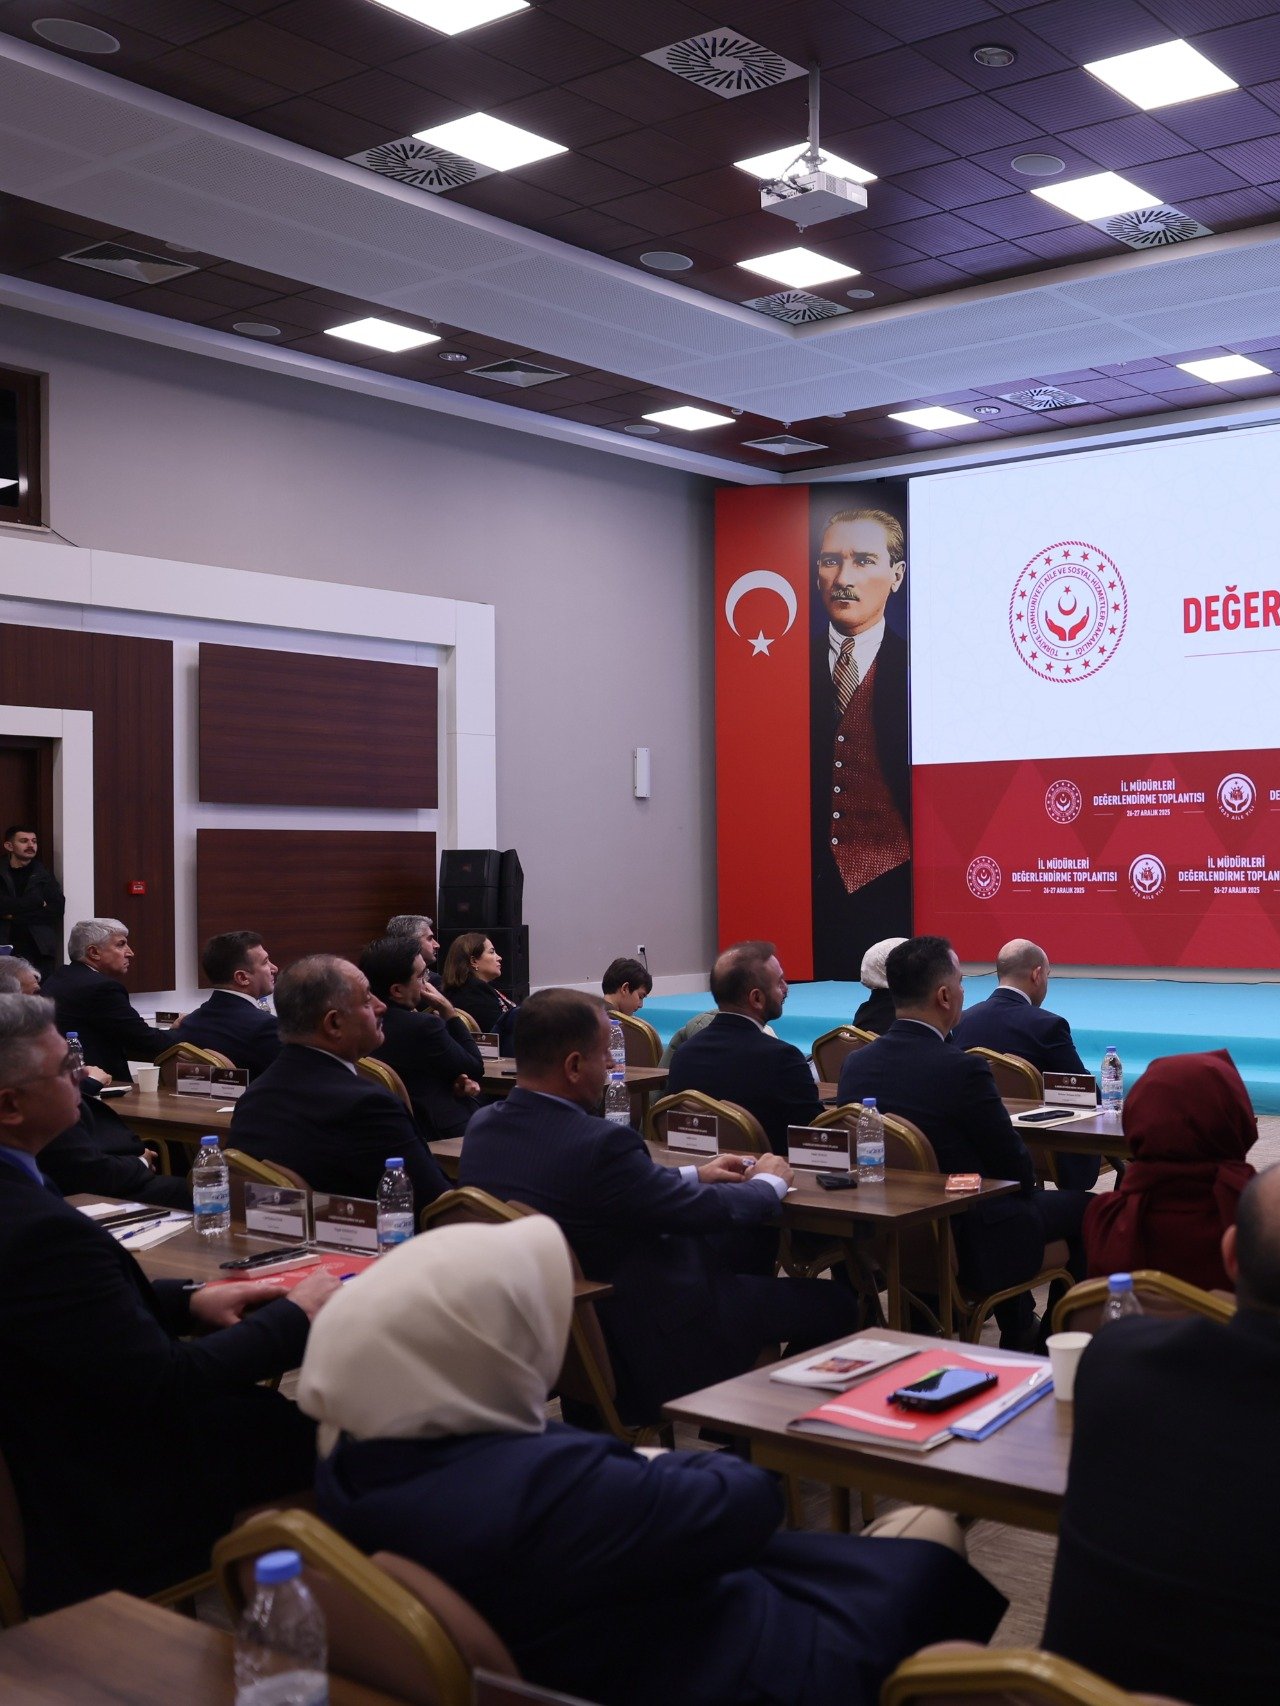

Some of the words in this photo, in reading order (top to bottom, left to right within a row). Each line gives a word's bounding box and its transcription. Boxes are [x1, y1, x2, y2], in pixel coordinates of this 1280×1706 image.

[1121, 780, 1129, 792] İL
[1130, 778, 1175, 791] MÜDÜRLERİ
[1094, 793, 1156, 805] DEĞERLENDİRME
[1158, 792, 1205, 804] TOPLANTISI
[1038, 858, 1046, 869] İL
[1047, 857, 1089, 869] MÜDÜRLERİ
[1208, 856, 1215, 867] İL
[1217, 855, 1265, 867] MÜDÜRLERİ
[1012, 870, 1071, 882] DEĞERLENDİRME
[1073, 871, 1117, 881] TOPLANTISI
[1179, 870, 1245, 881] DEĞERLENDİRME
